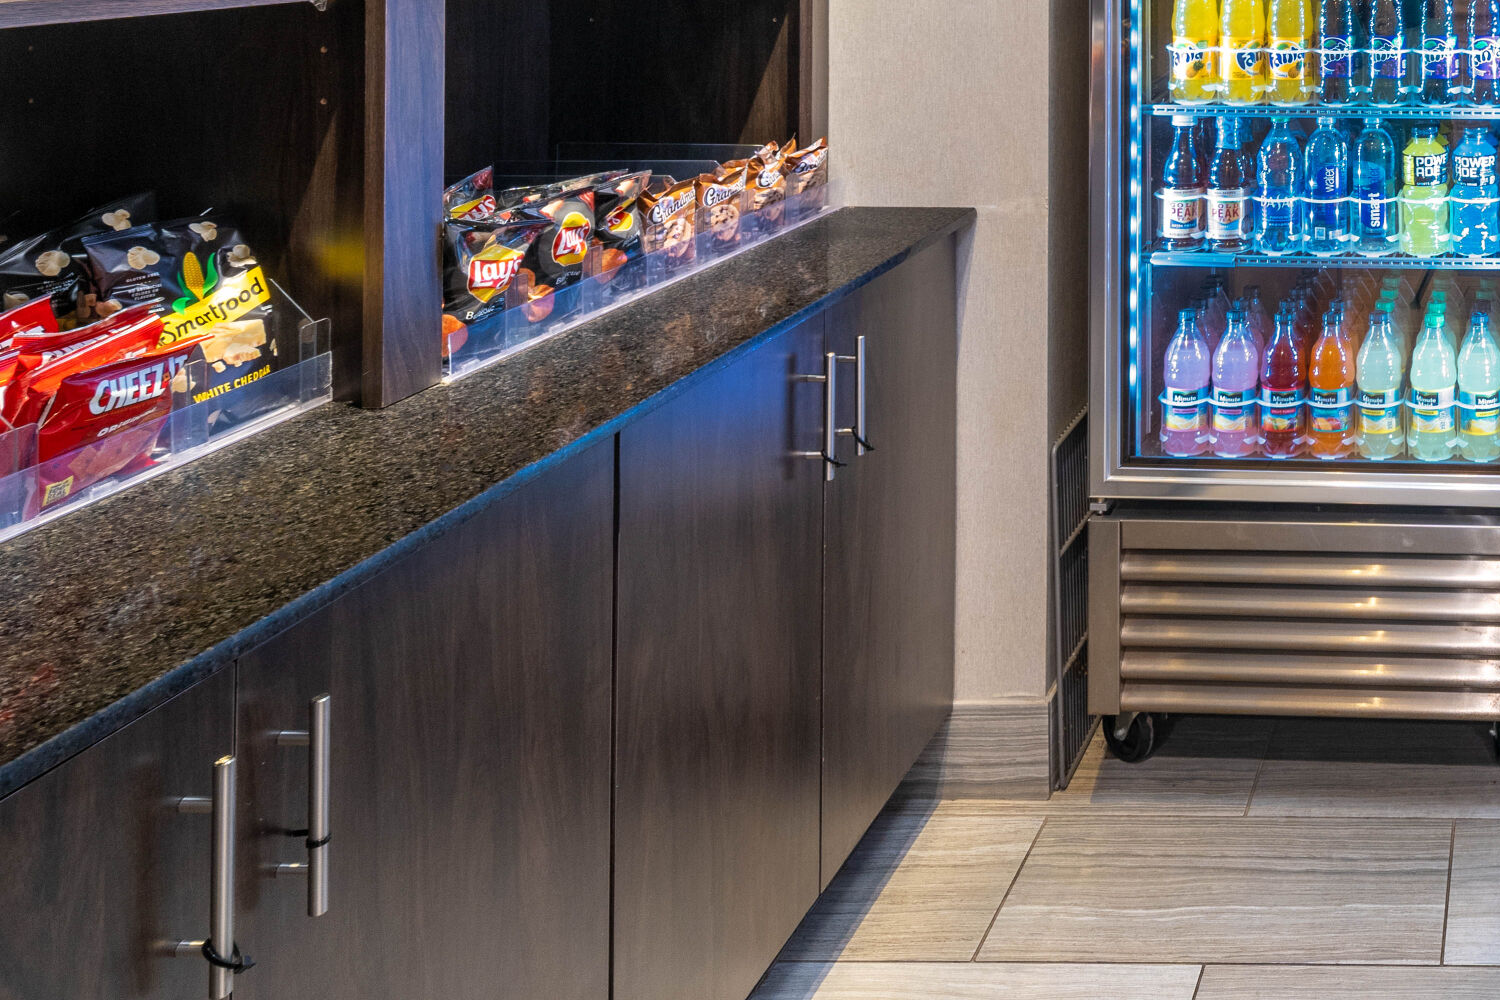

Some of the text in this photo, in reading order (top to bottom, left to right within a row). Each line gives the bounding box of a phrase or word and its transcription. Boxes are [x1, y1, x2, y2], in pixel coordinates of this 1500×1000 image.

[1325, 167, 1335, 193] water
[1212, 208, 1240, 218] PEAK
[1370, 192, 1381, 228] smart
[162, 276, 265, 344] Smartfood
[193, 363, 272, 404] WHITE CHEDDAR
